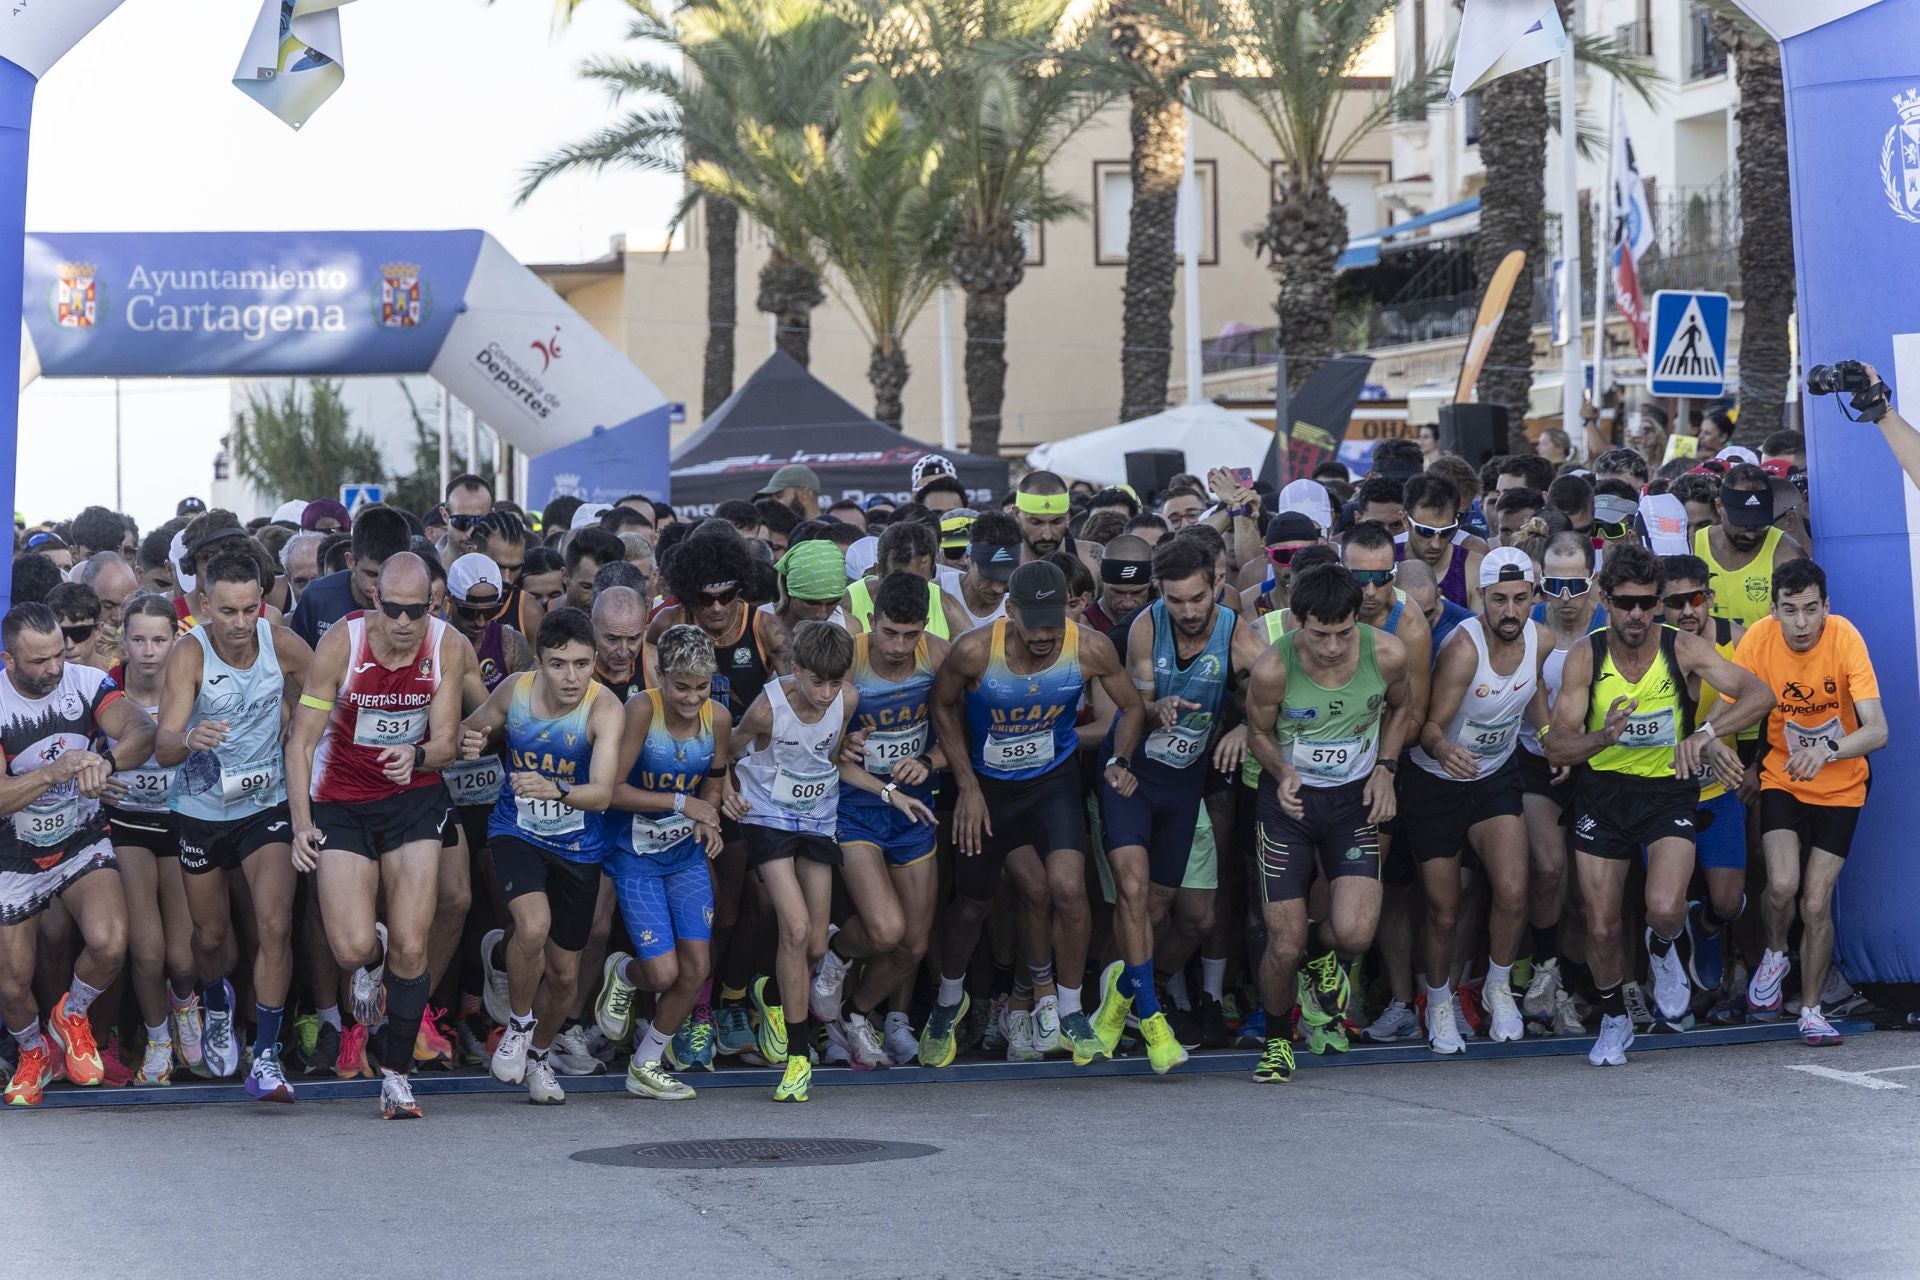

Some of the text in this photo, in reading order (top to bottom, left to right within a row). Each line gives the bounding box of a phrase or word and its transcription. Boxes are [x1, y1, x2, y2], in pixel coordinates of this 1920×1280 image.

[127, 263, 347, 296] Ayuntamiento
[126, 295, 347, 341] Cartagena
[476, 349, 551, 418] Deportes
[350, 692, 431, 707] PUERTAS LORCA
[376, 719, 410, 734] 531
[1624, 721, 1659, 736] 488
[1167, 735, 1199, 754] 786
[1475, 730, 1506, 745] 451
[876, 738, 920, 759] 1280
[1002, 742, 1037, 758] 583
[1312, 749, 1347, 764] 579
[510, 749, 576, 776] UCAM
[136, 774, 168, 791] 321
[241, 772, 270, 791] 991
[454, 770, 496, 790] 1260
[792, 783, 825, 798] 608
[528, 800, 574, 817] 1119
[32, 813, 65, 832] 388
